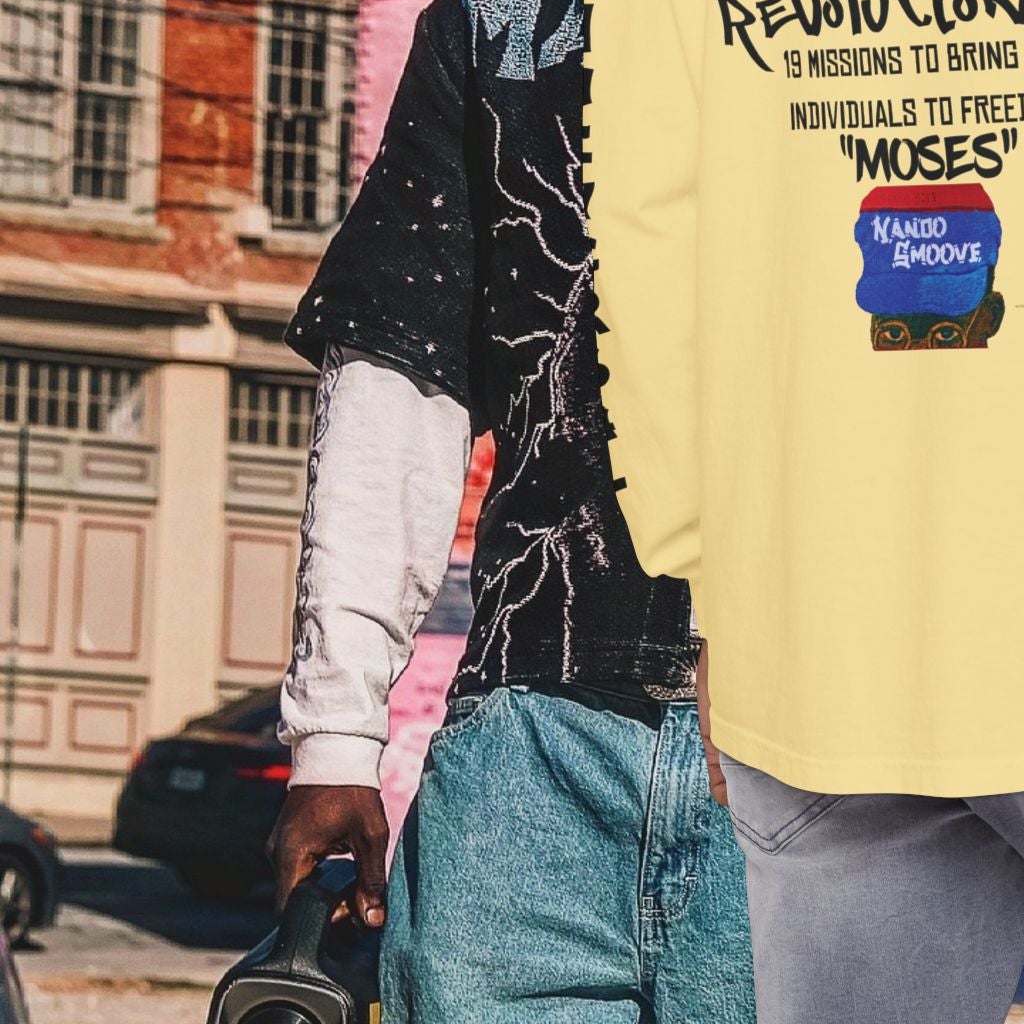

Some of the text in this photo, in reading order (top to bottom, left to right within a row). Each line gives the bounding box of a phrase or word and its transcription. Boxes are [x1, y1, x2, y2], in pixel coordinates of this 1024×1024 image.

[784, 50, 802, 78] 19
[808, 46, 902, 78] MISSIONS
[910, 44, 939, 74] TO
[947, 40, 1019, 71] BRING
[791, 98, 917, 130] INDIVIDUALS
[924, 97, 953, 126] TO
[871, 216, 948, 244] NANDO
